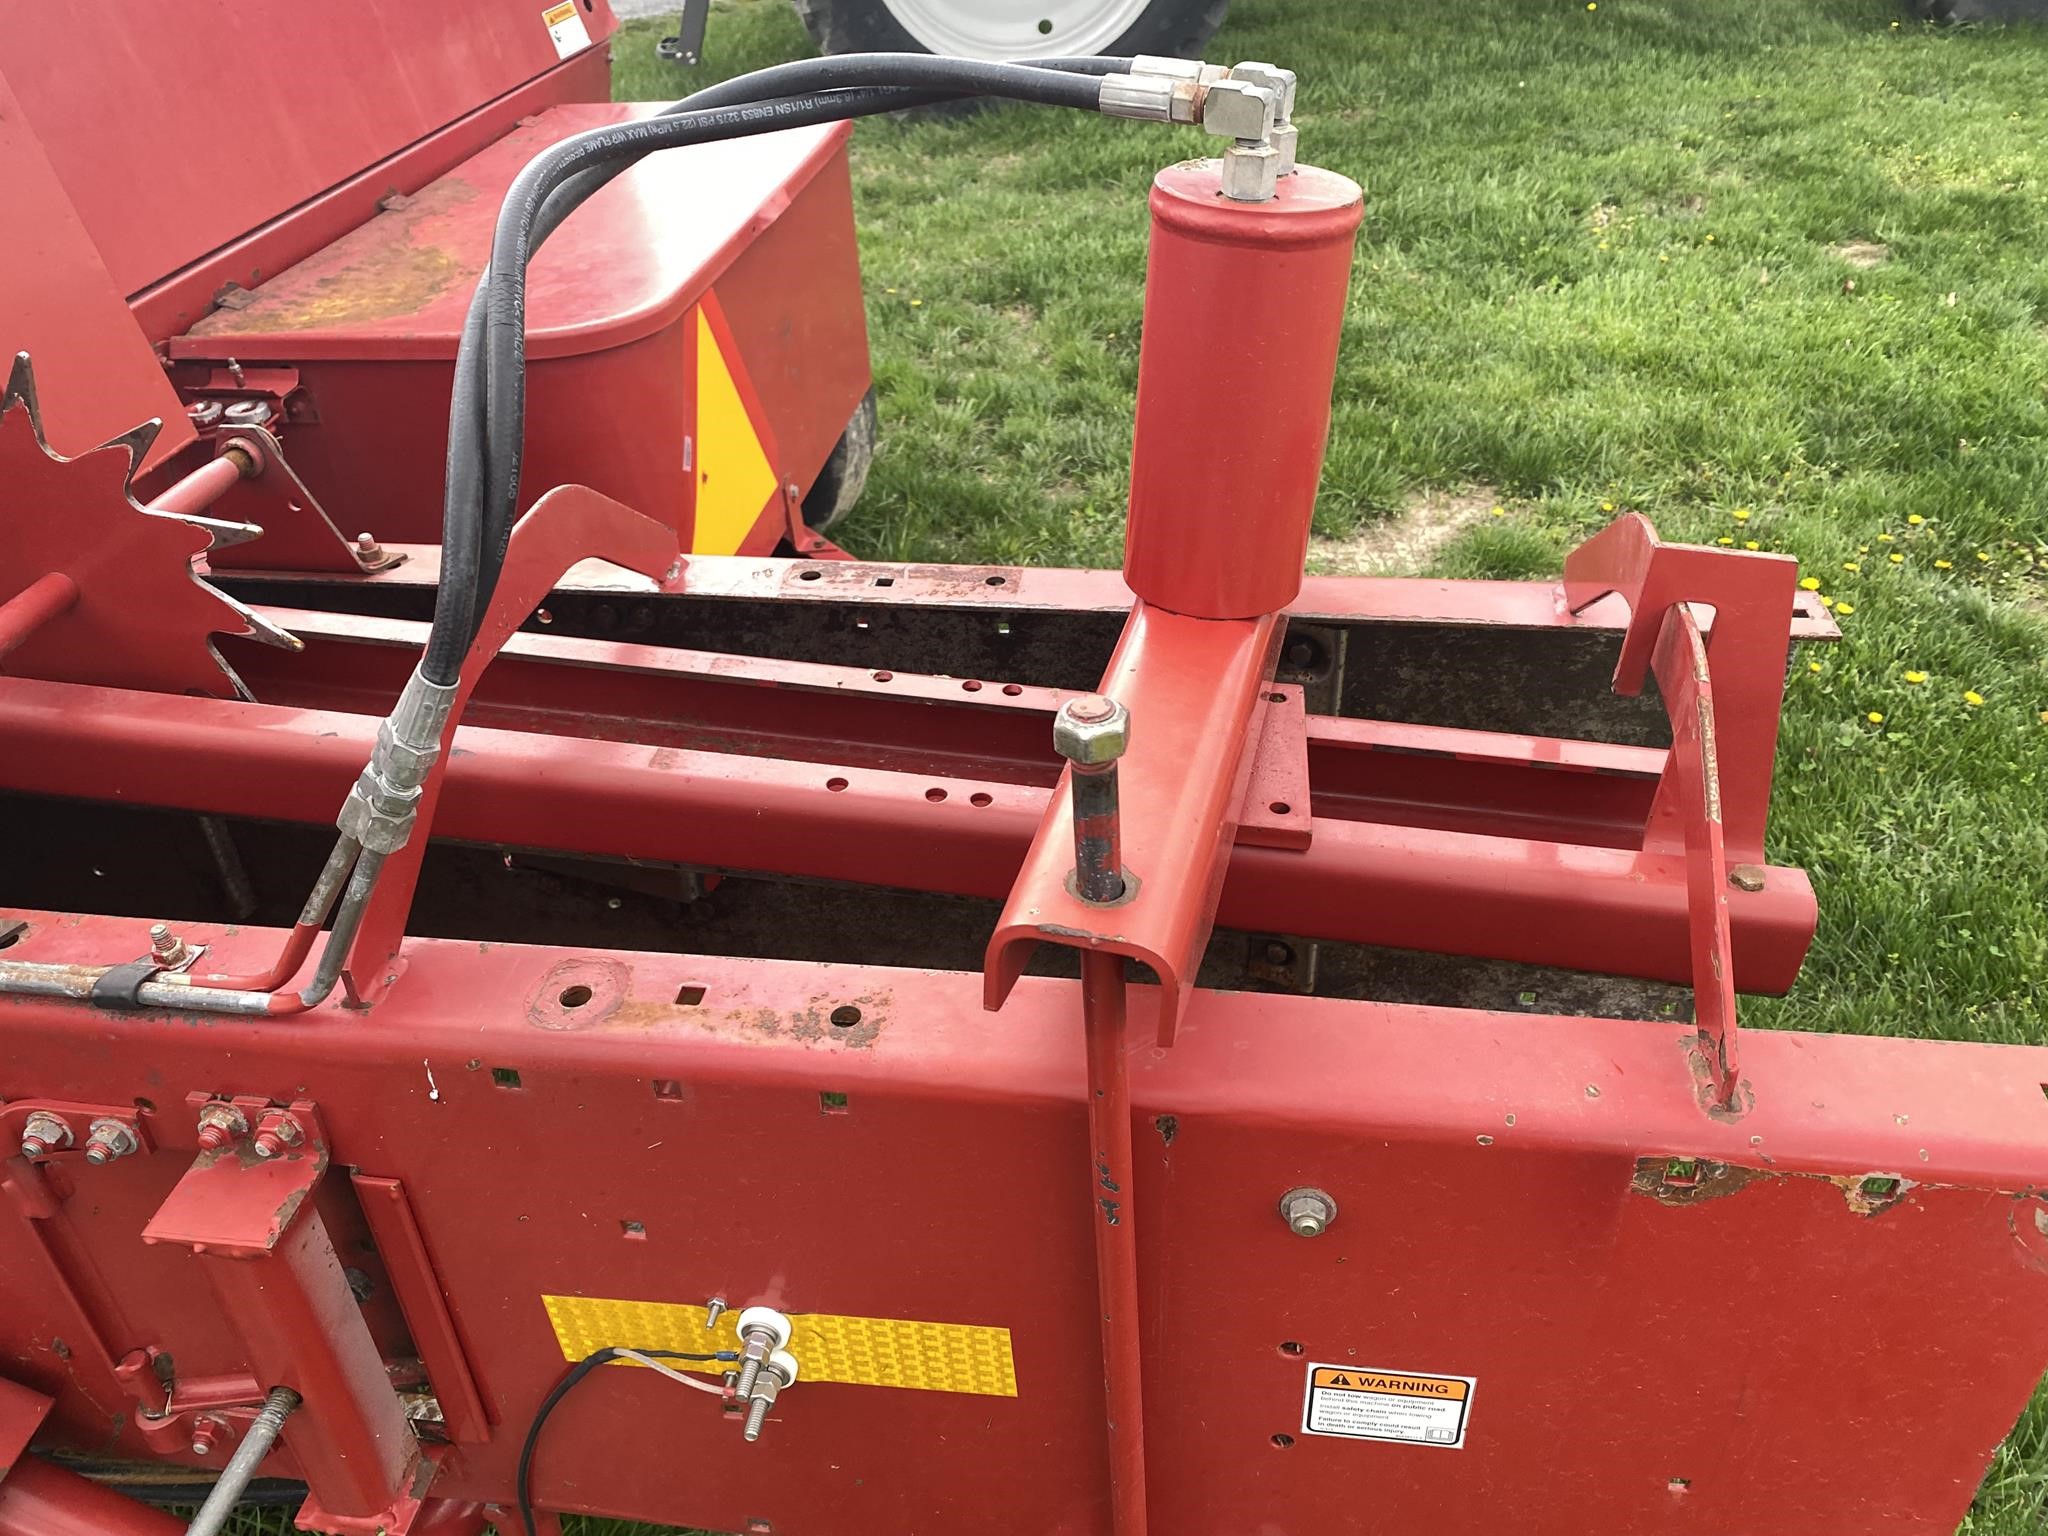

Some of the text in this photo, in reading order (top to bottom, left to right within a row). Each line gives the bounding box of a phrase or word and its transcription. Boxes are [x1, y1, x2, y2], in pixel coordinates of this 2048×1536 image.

[776, 98, 813, 115] R1/1SN
[814, 90, 855, 109] (6.3mm)
[715, 111, 739, 125] 3275
[741, 106, 773, 120] EN853
[697, 115, 714, 129] PSI
[626, 127, 648, 141] MAX
[584, 136, 612, 153] FLAME
[1358, 1377, 1449, 1394] WARNING
